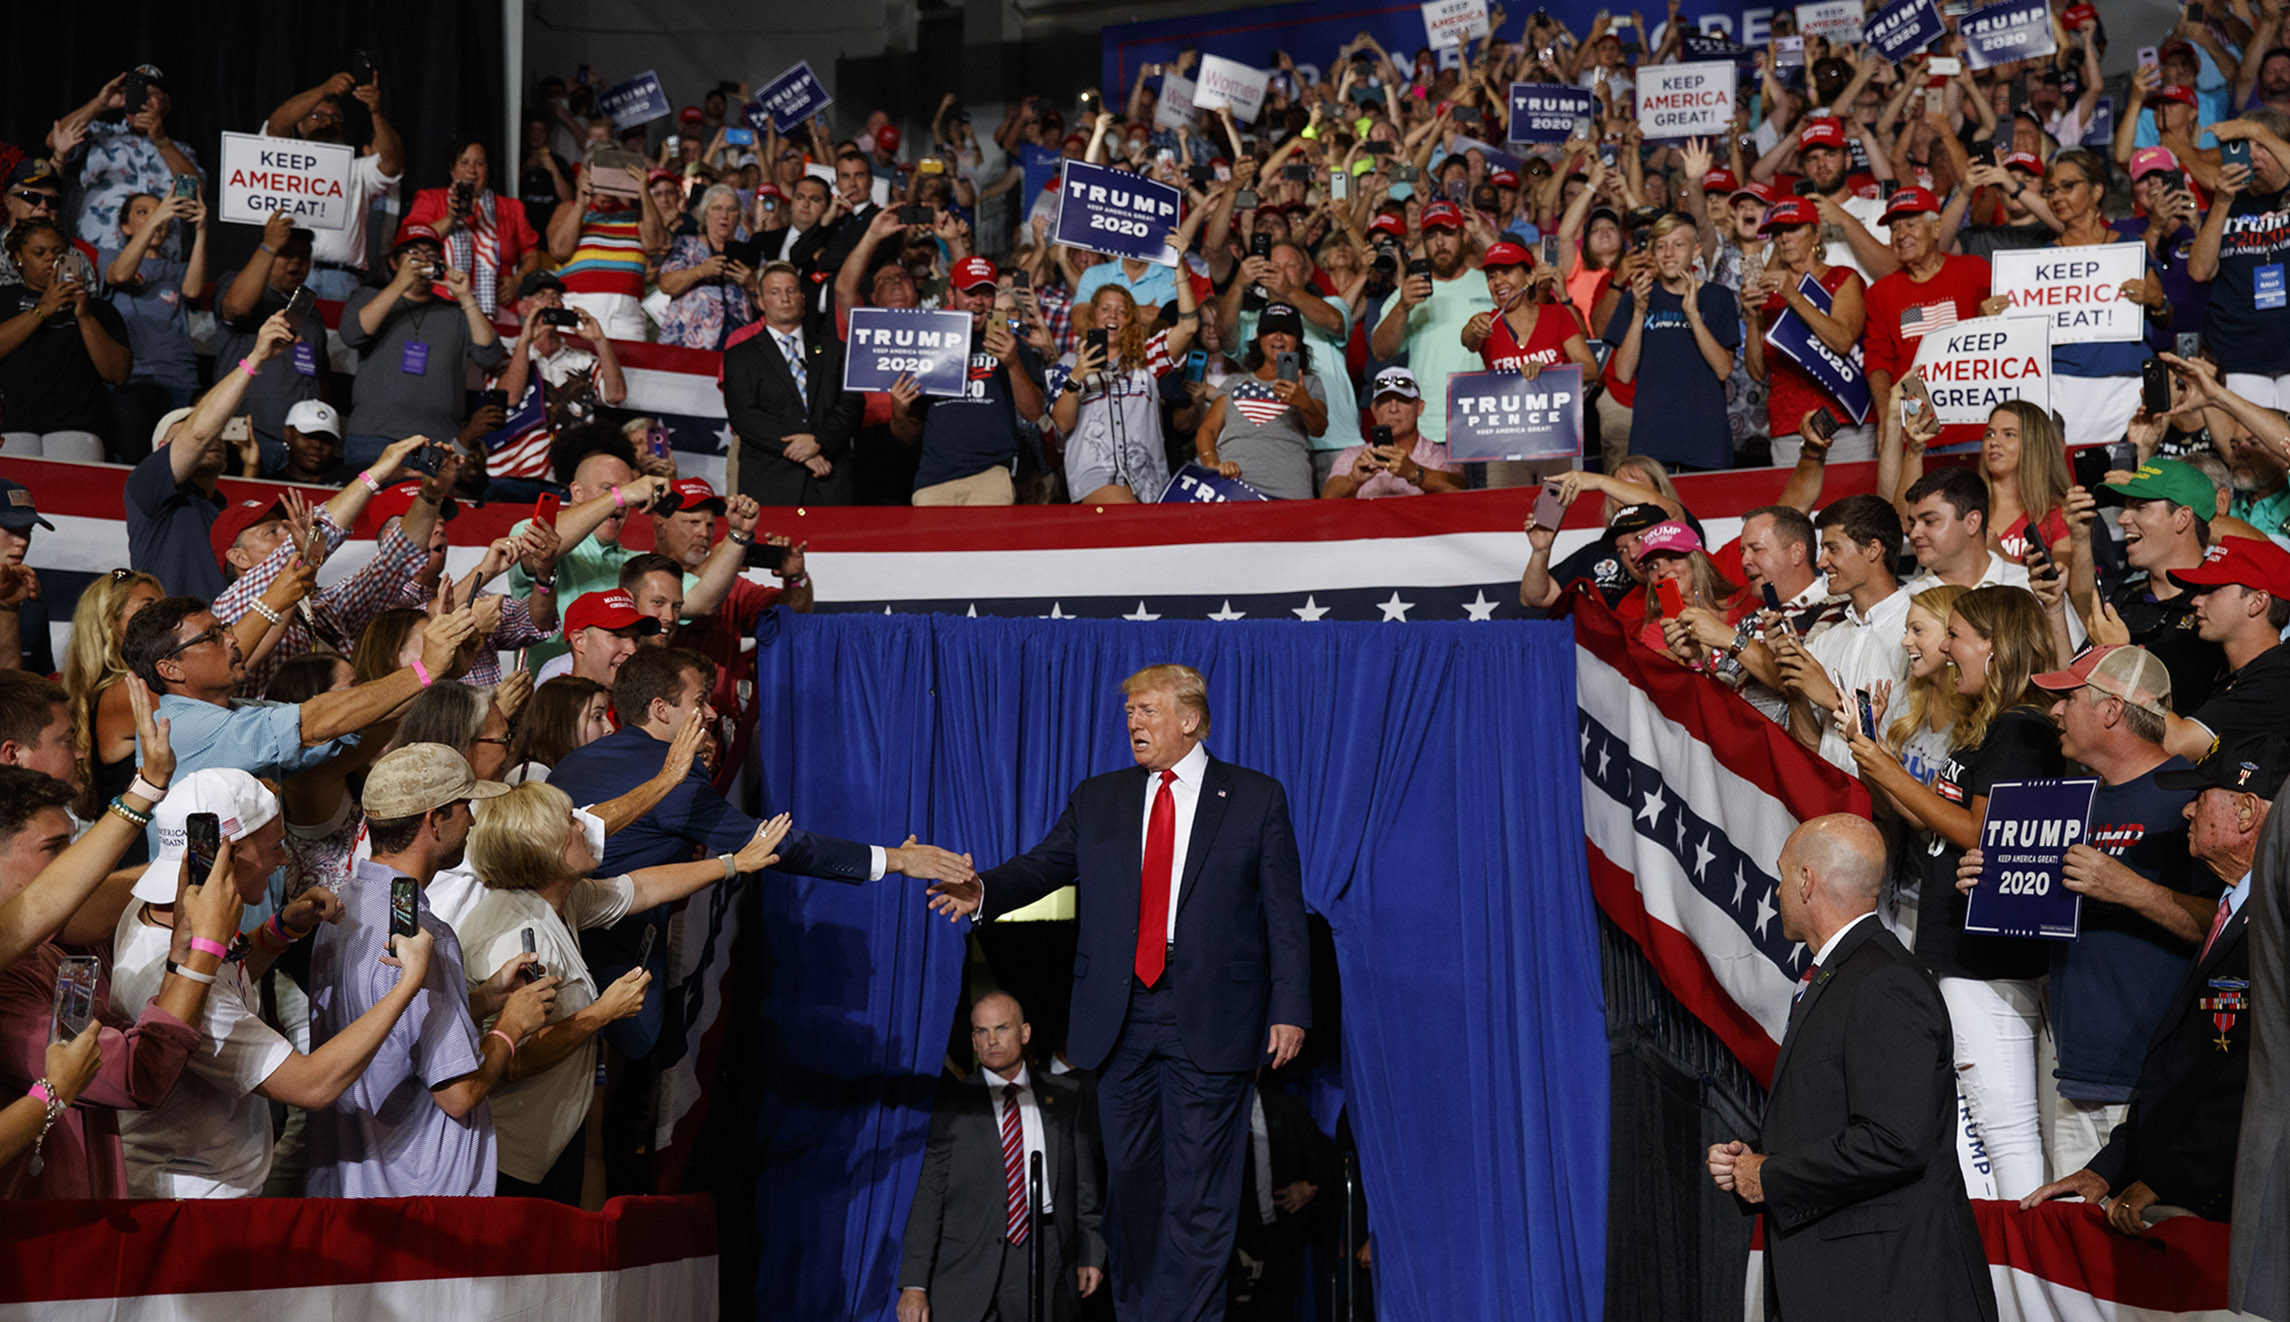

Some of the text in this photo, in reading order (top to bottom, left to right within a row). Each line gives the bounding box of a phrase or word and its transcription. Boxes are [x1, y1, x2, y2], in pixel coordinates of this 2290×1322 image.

[1962, 7, 2045, 36] TRUMP
[1883, 22, 1921, 52] 2020
[1982, 31, 2028, 52] 2020
[765, 74, 811, 111] TRUMP
[1206, 69, 1261, 101] Women
[1662, 75, 1704, 91] KEEP
[603, 82, 656, 109] TRUMP
[1514, 97, 1589, 113] TRUMP
[1643, 91, 1728, 111] AMERICA
[1531, 118, 1573, 131] 2020
[1655, 110, 1715, 127] GREAT!
[261, 150, 317, 171] KEEP
[229, 169, 343, 199] AMERICA
[247, 194, 326, 218] GREAT!
[1069, 180, 1175, 217] TRUMP
[1087, 203, 1104, 212] KEEP
[1104, 206, 1132, 218] AMERICA
[1090, 213, 1149, 238] 2020
[2036, 261, 2099, 281] KEEP
[2007, 283, 2127, 307] AMERICA
[2051, 309, 2112, 328] EAT!
[855, 328, 963, 348] TRUMP
[1947, 332, 2007, 353] KEEP
[876, 357, 934, 373] 2020
[1492, 349, 1557, 371] TRUMP
[1806, 334, 1854, 383] 2020
[1918, 357, 2041, 382] AMERICA
[1458, 392, 1571, 414] TRUMP
[1931, 387, 2020, 407] GREAT!
[1468, 411, 1560, 427] PENCE
[1527, 425, 1552, 433] GREAT!
[1644, 525, 1682, 543] TRUMP
[1987, 819, 2081, 848] TRUMP
[2088, 823, 2145, 856] UMP
[1998, 854, 2059, 864] KEEP AMERICA GREAT!
[1999, 871, 2050, 896] 2020
[1958, 1094, 1991, 1175] TRUMP
